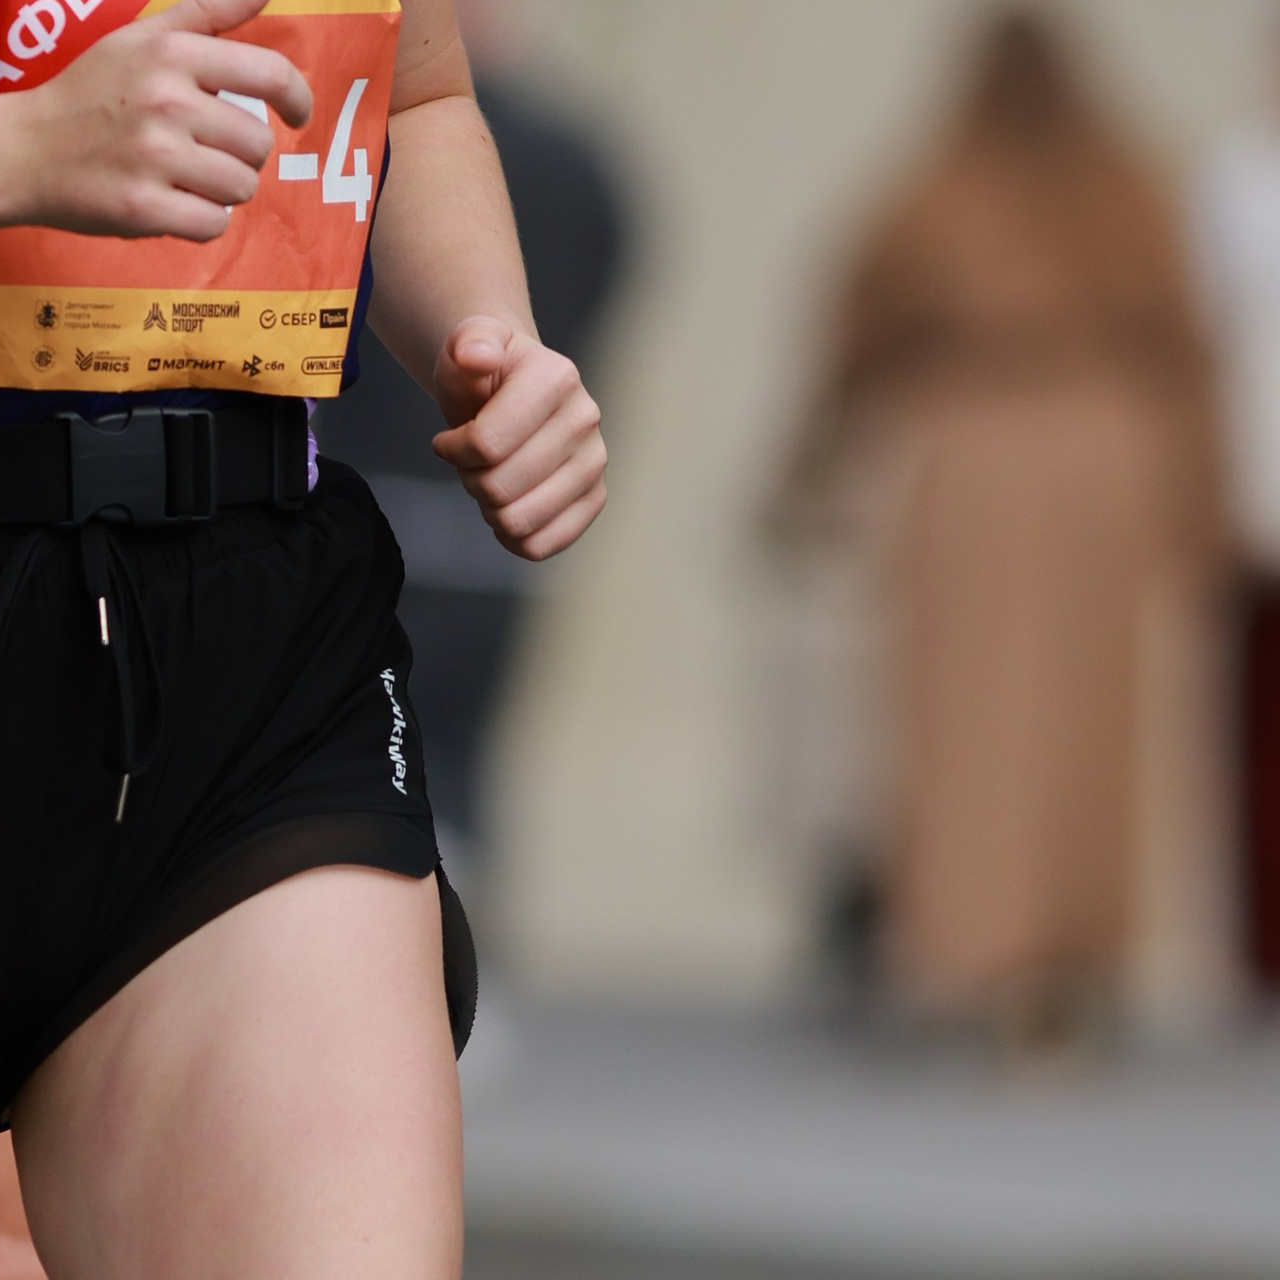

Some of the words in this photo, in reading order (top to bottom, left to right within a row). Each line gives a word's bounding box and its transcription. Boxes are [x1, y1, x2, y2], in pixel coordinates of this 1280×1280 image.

[216, 77, 373, 222] -4
[172, 301, 240, 318] МОСКОВСКИЙ
[172, 319, 204, 332] СПОРТ
[281, 312, 317, 326] СБЕР
[93, 361, 130, 373] BRICS
